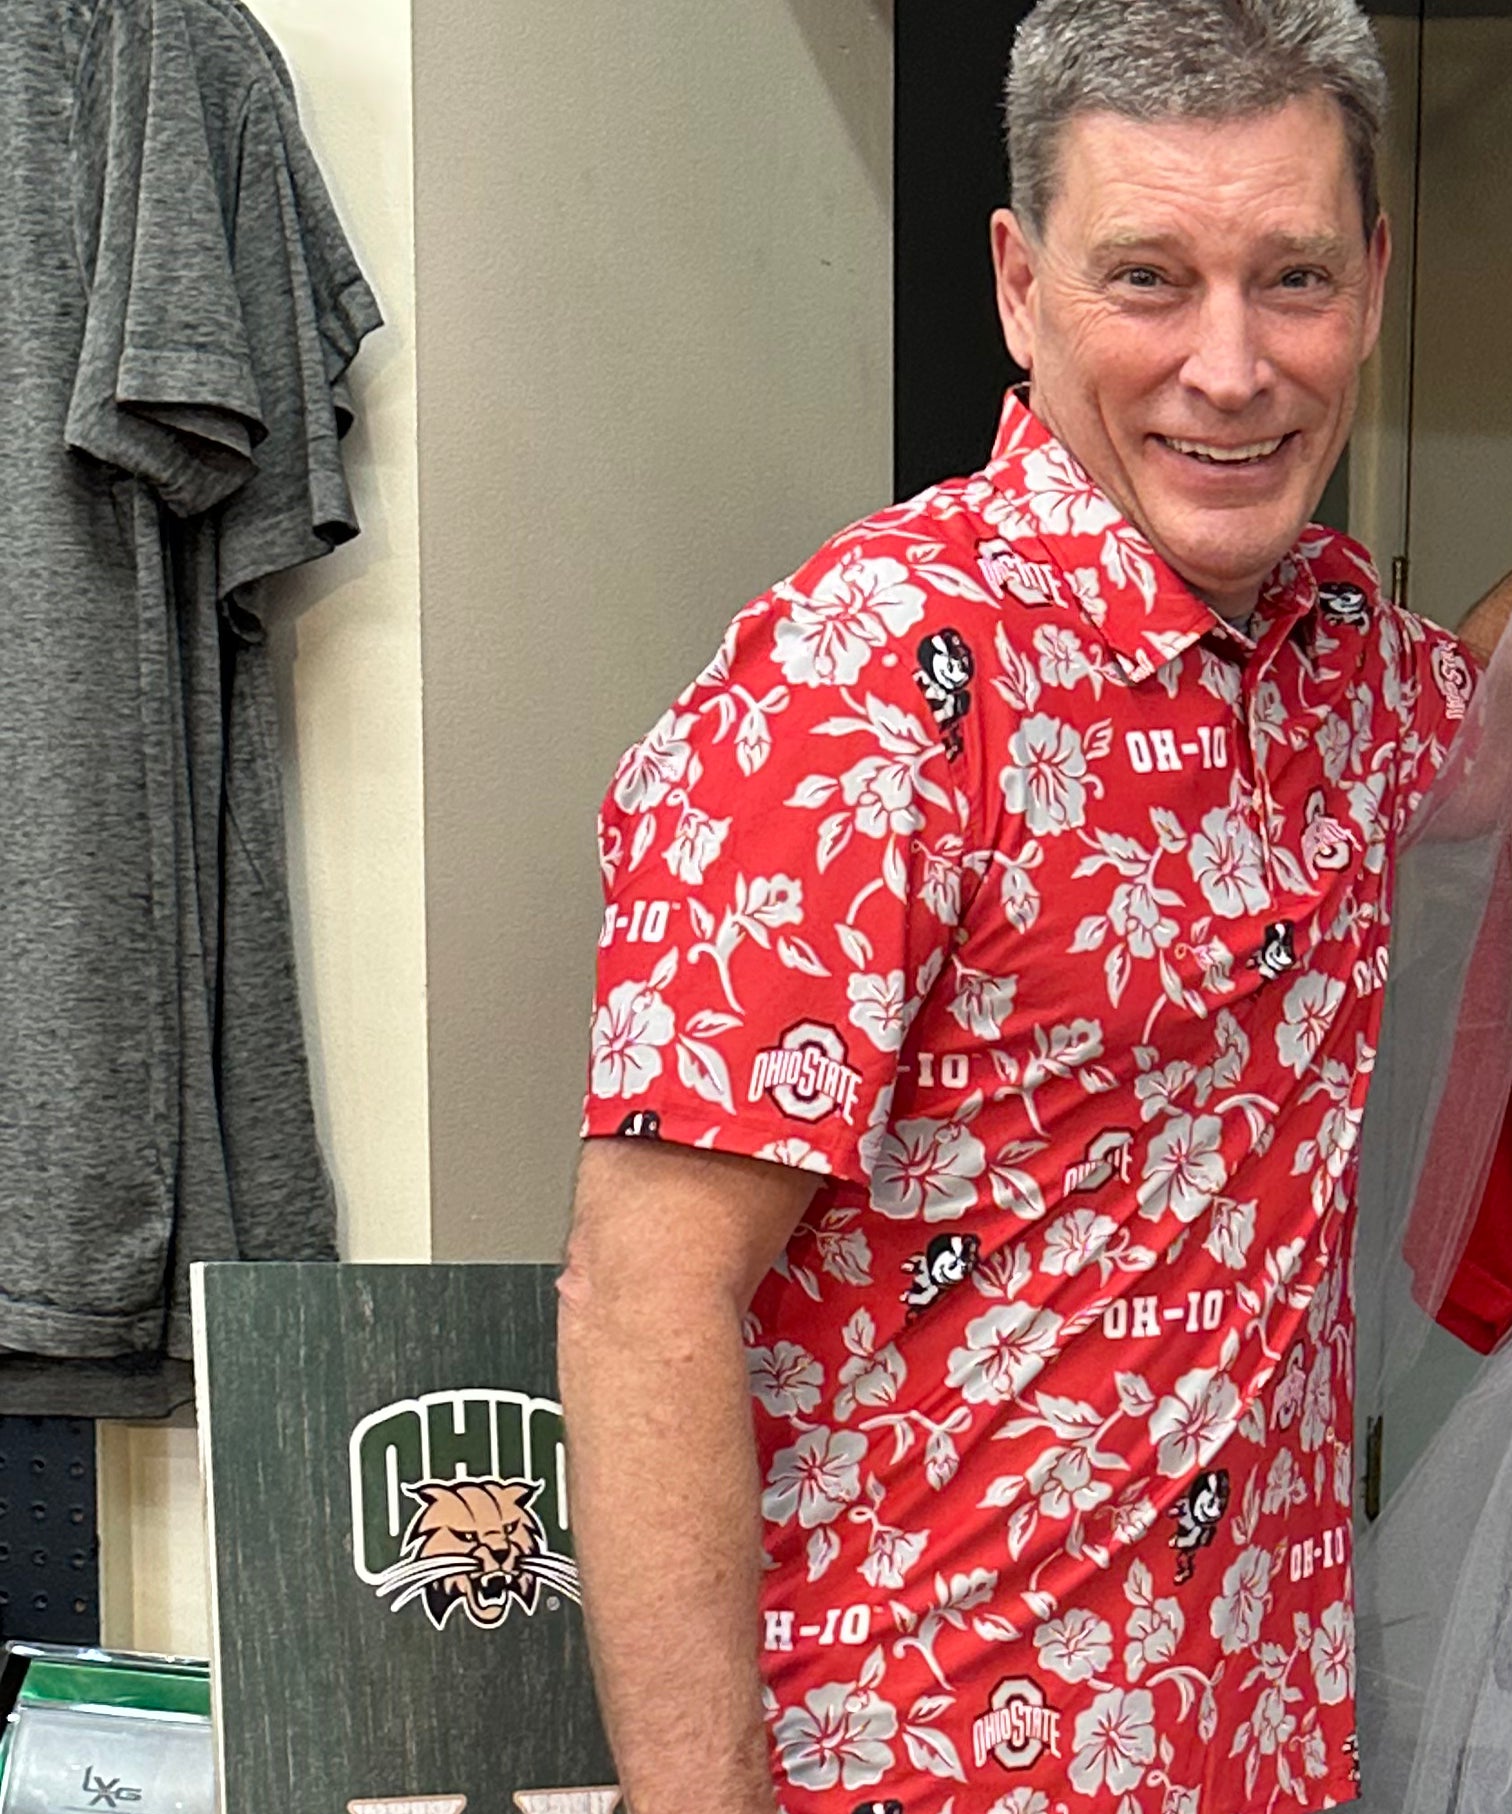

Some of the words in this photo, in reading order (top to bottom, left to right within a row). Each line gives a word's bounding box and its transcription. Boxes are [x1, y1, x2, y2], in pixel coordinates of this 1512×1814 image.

[1125, 726, 1228, 774] OH-IO
[1103, 1289, 1224, 1340] OH-IO
[1290, 1525, 1345, 1582] OH-IO
[763, 1603, 871, 1652] H-IO
